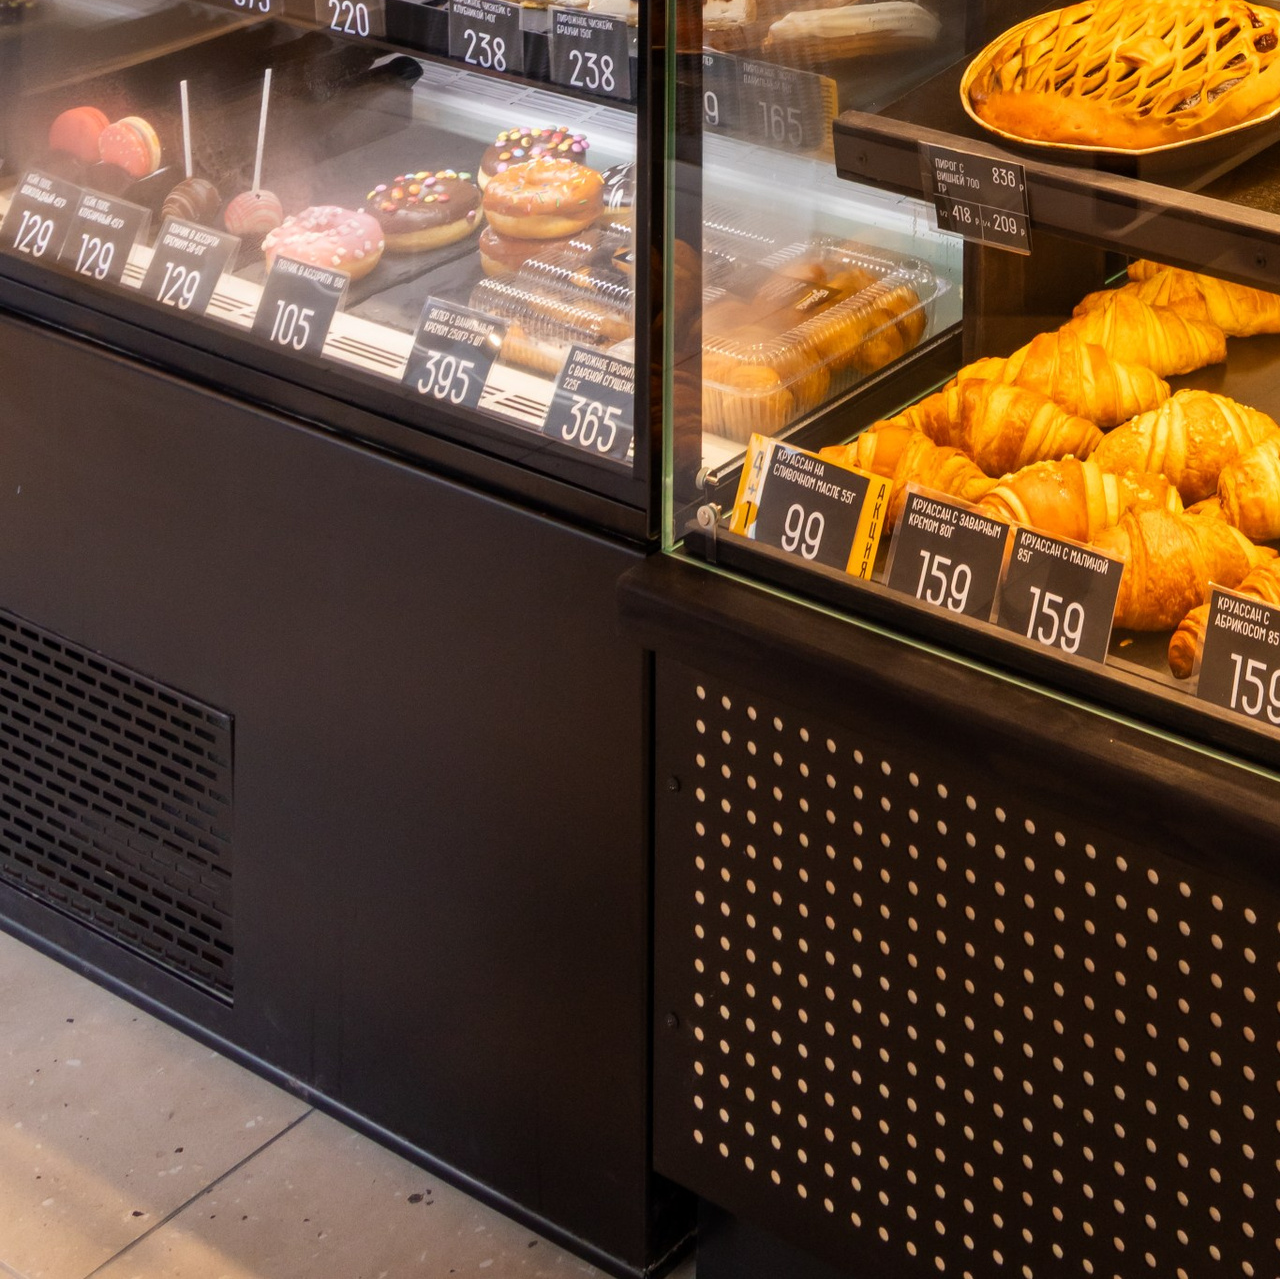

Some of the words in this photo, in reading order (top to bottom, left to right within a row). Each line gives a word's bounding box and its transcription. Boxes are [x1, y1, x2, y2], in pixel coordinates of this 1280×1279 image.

[464, 29, 507, 71] 238
[569, 49, 615, 91] 238
[12, 210, 54, 258] 129
[75, 234, 115, 280] 129
[156, 262, 201, 310] 129
[271, 300, 315, 350] 105
[418, 350, 474, 404] 395
[562, 395, 622, 452] 365
[781, 503, 825, 560] 99
[916, 549, 972, 614] 159
[1027, 585, 1085, 654] 159
